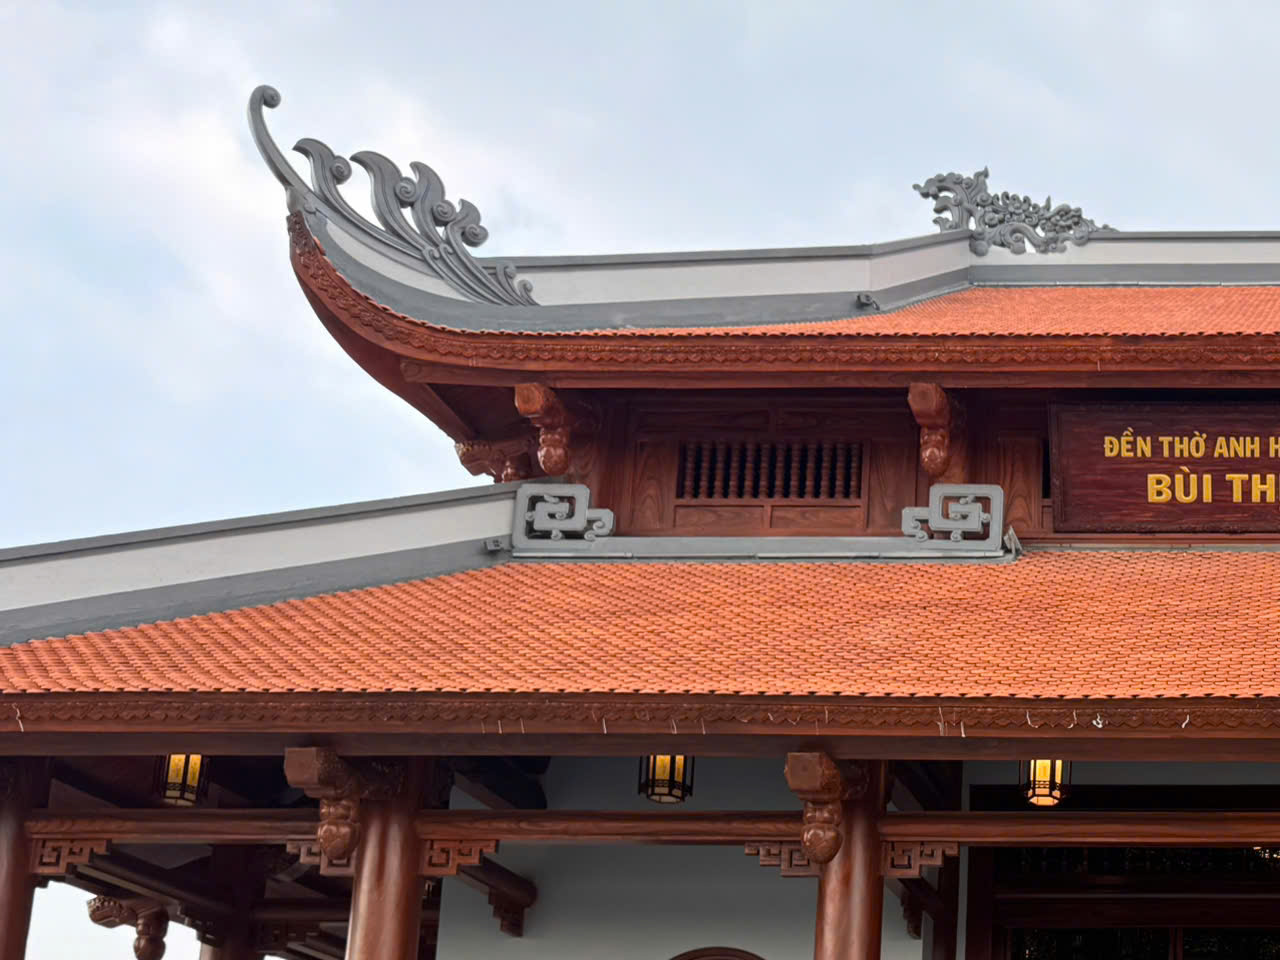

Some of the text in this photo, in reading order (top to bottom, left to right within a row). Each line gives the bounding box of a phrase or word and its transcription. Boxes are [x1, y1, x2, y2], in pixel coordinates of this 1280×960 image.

[1103, 427, 1152, 458] ĐỀN
[1158, 431, 1207, 458] THỜ
[1213, 436, 1260, 458] ANH
[1147, 465, 1213, 503] BÙI
